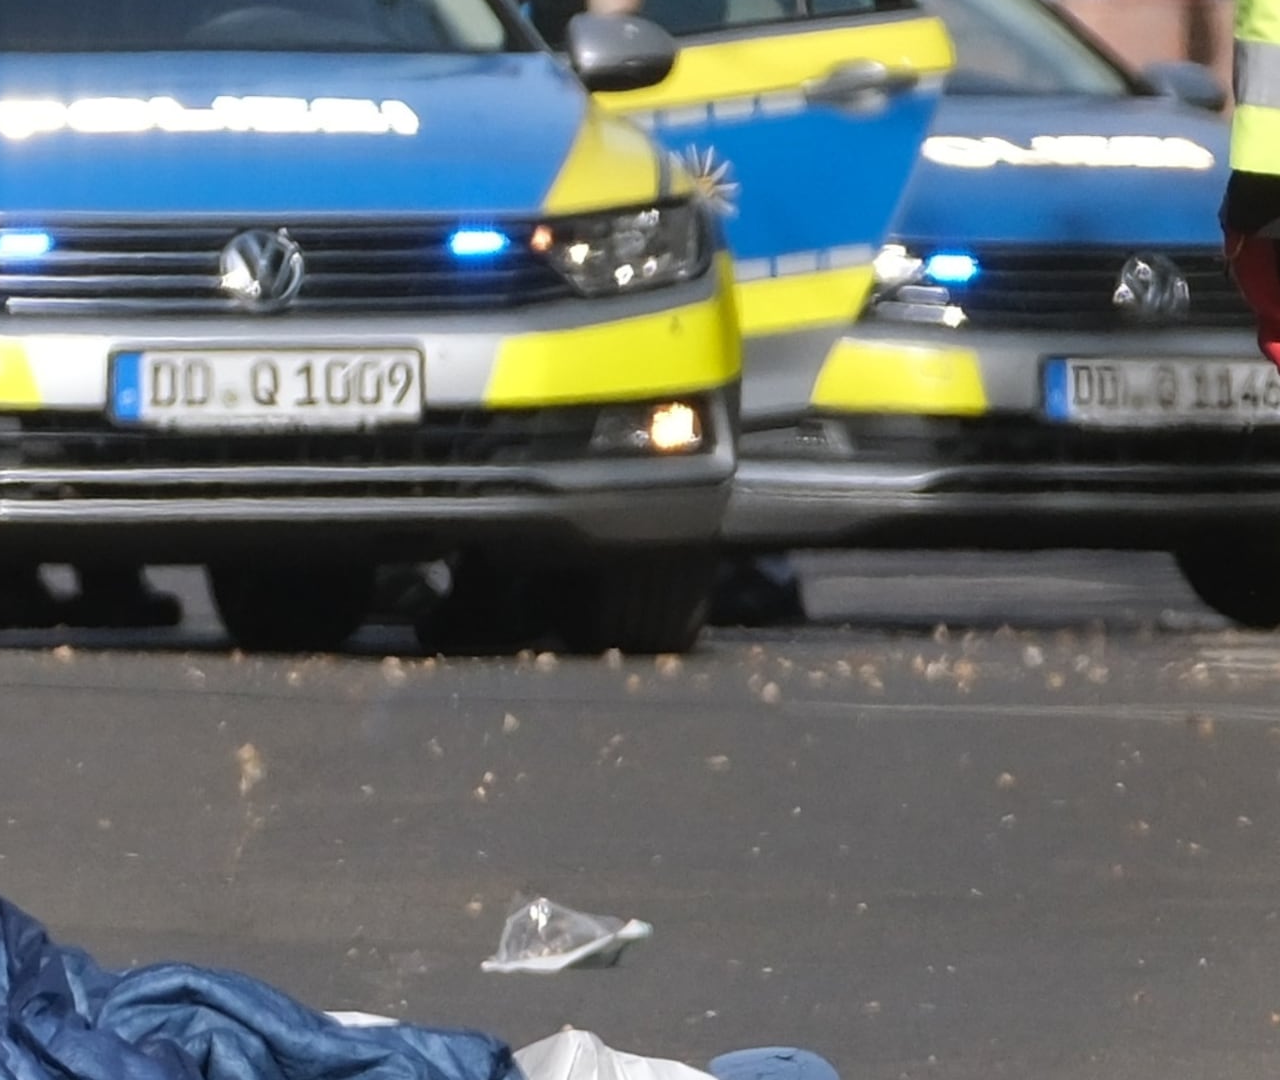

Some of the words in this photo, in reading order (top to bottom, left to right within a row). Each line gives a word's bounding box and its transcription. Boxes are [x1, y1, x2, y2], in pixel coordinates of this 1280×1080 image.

[150, 358, 214, 407] DD
[250, 358, 280, 407] Q
[295, 358, 415, 407] 1009
[1072, 364, 1119, 407] DD
